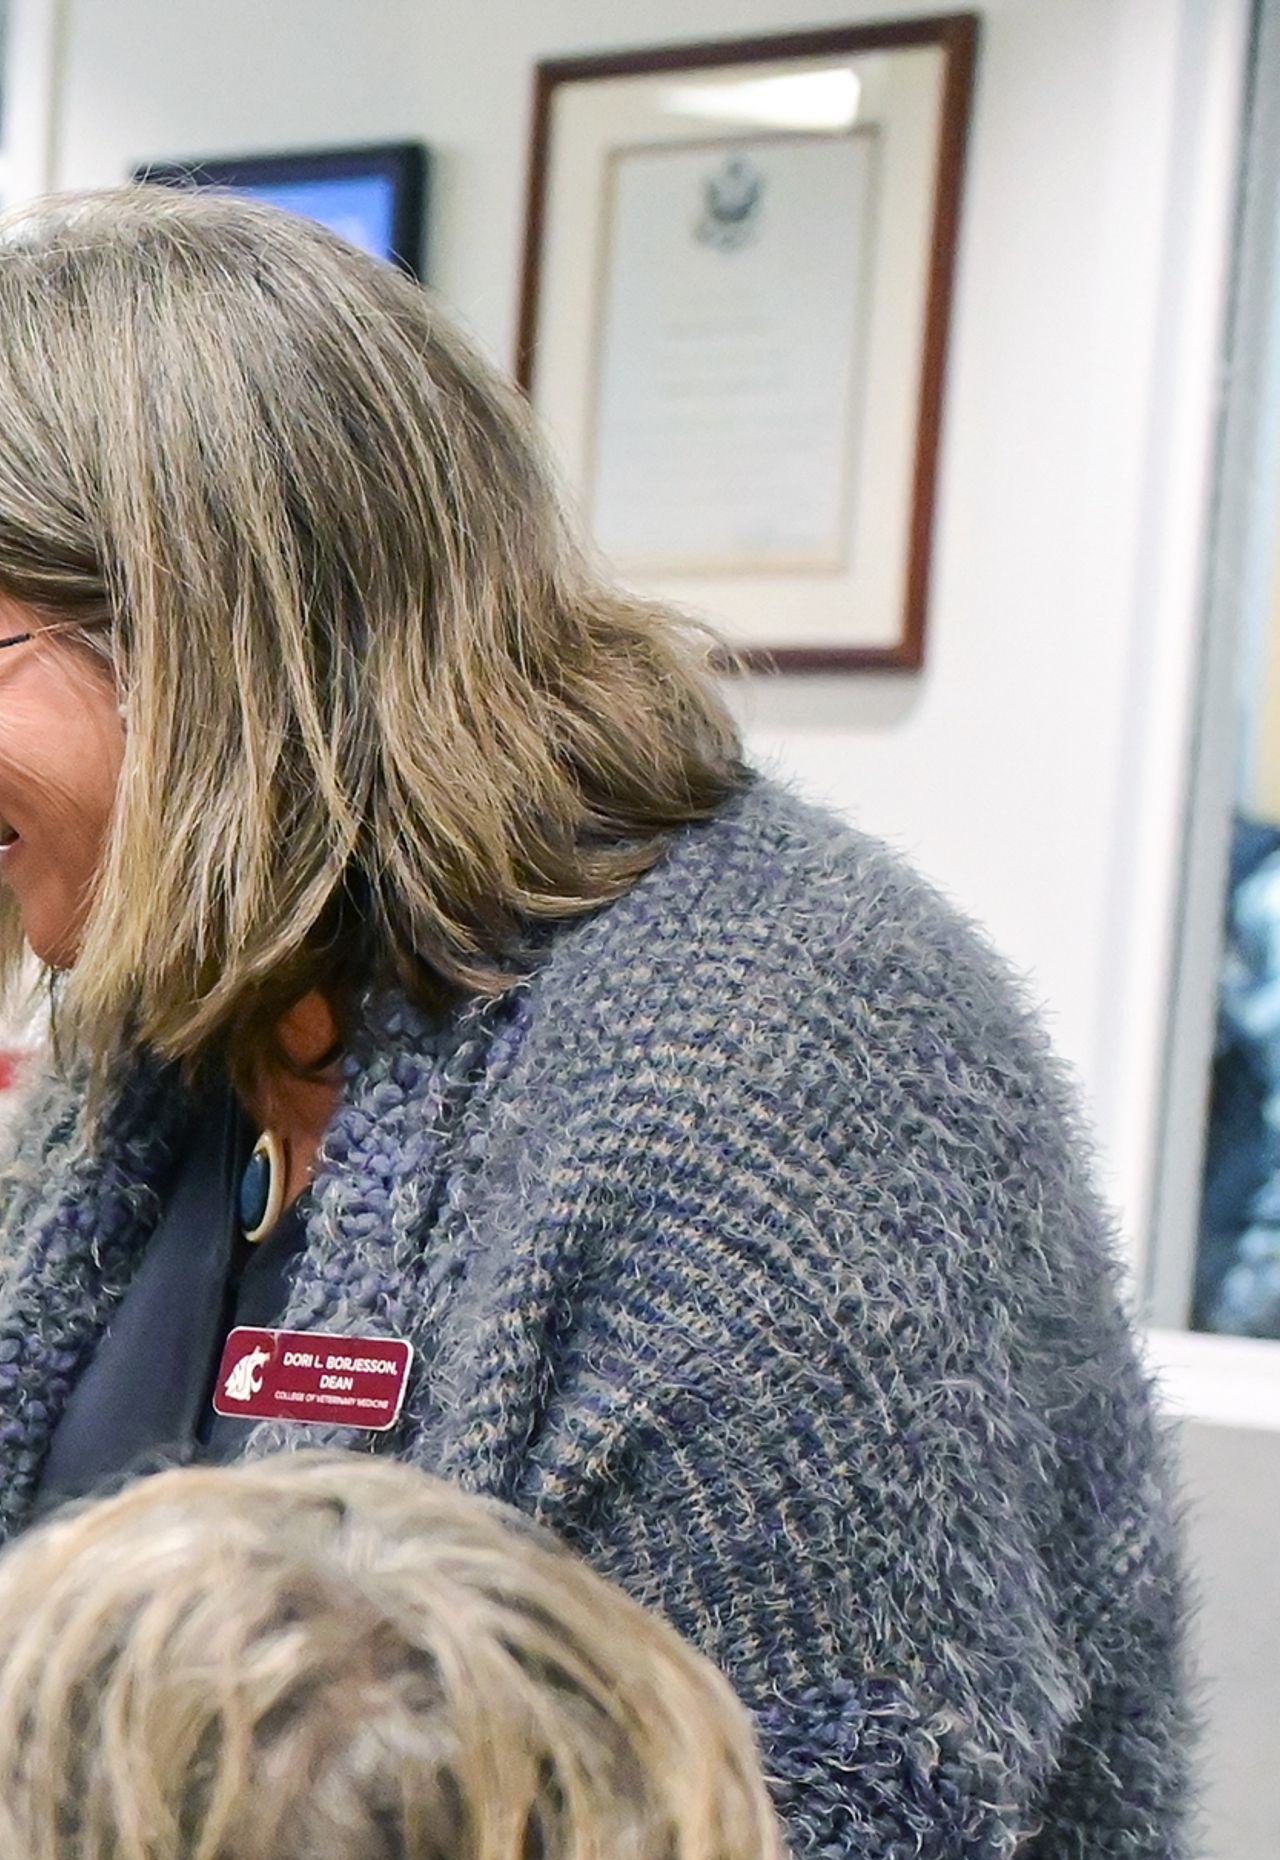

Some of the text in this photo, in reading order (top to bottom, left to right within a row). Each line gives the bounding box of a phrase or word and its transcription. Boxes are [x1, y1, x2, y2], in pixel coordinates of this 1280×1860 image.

[283, 1352, 313, 1367] DORI
[319, 1375, 354, 1390] DEAN
[274, 1390, 305, 1402] COLLEGE
